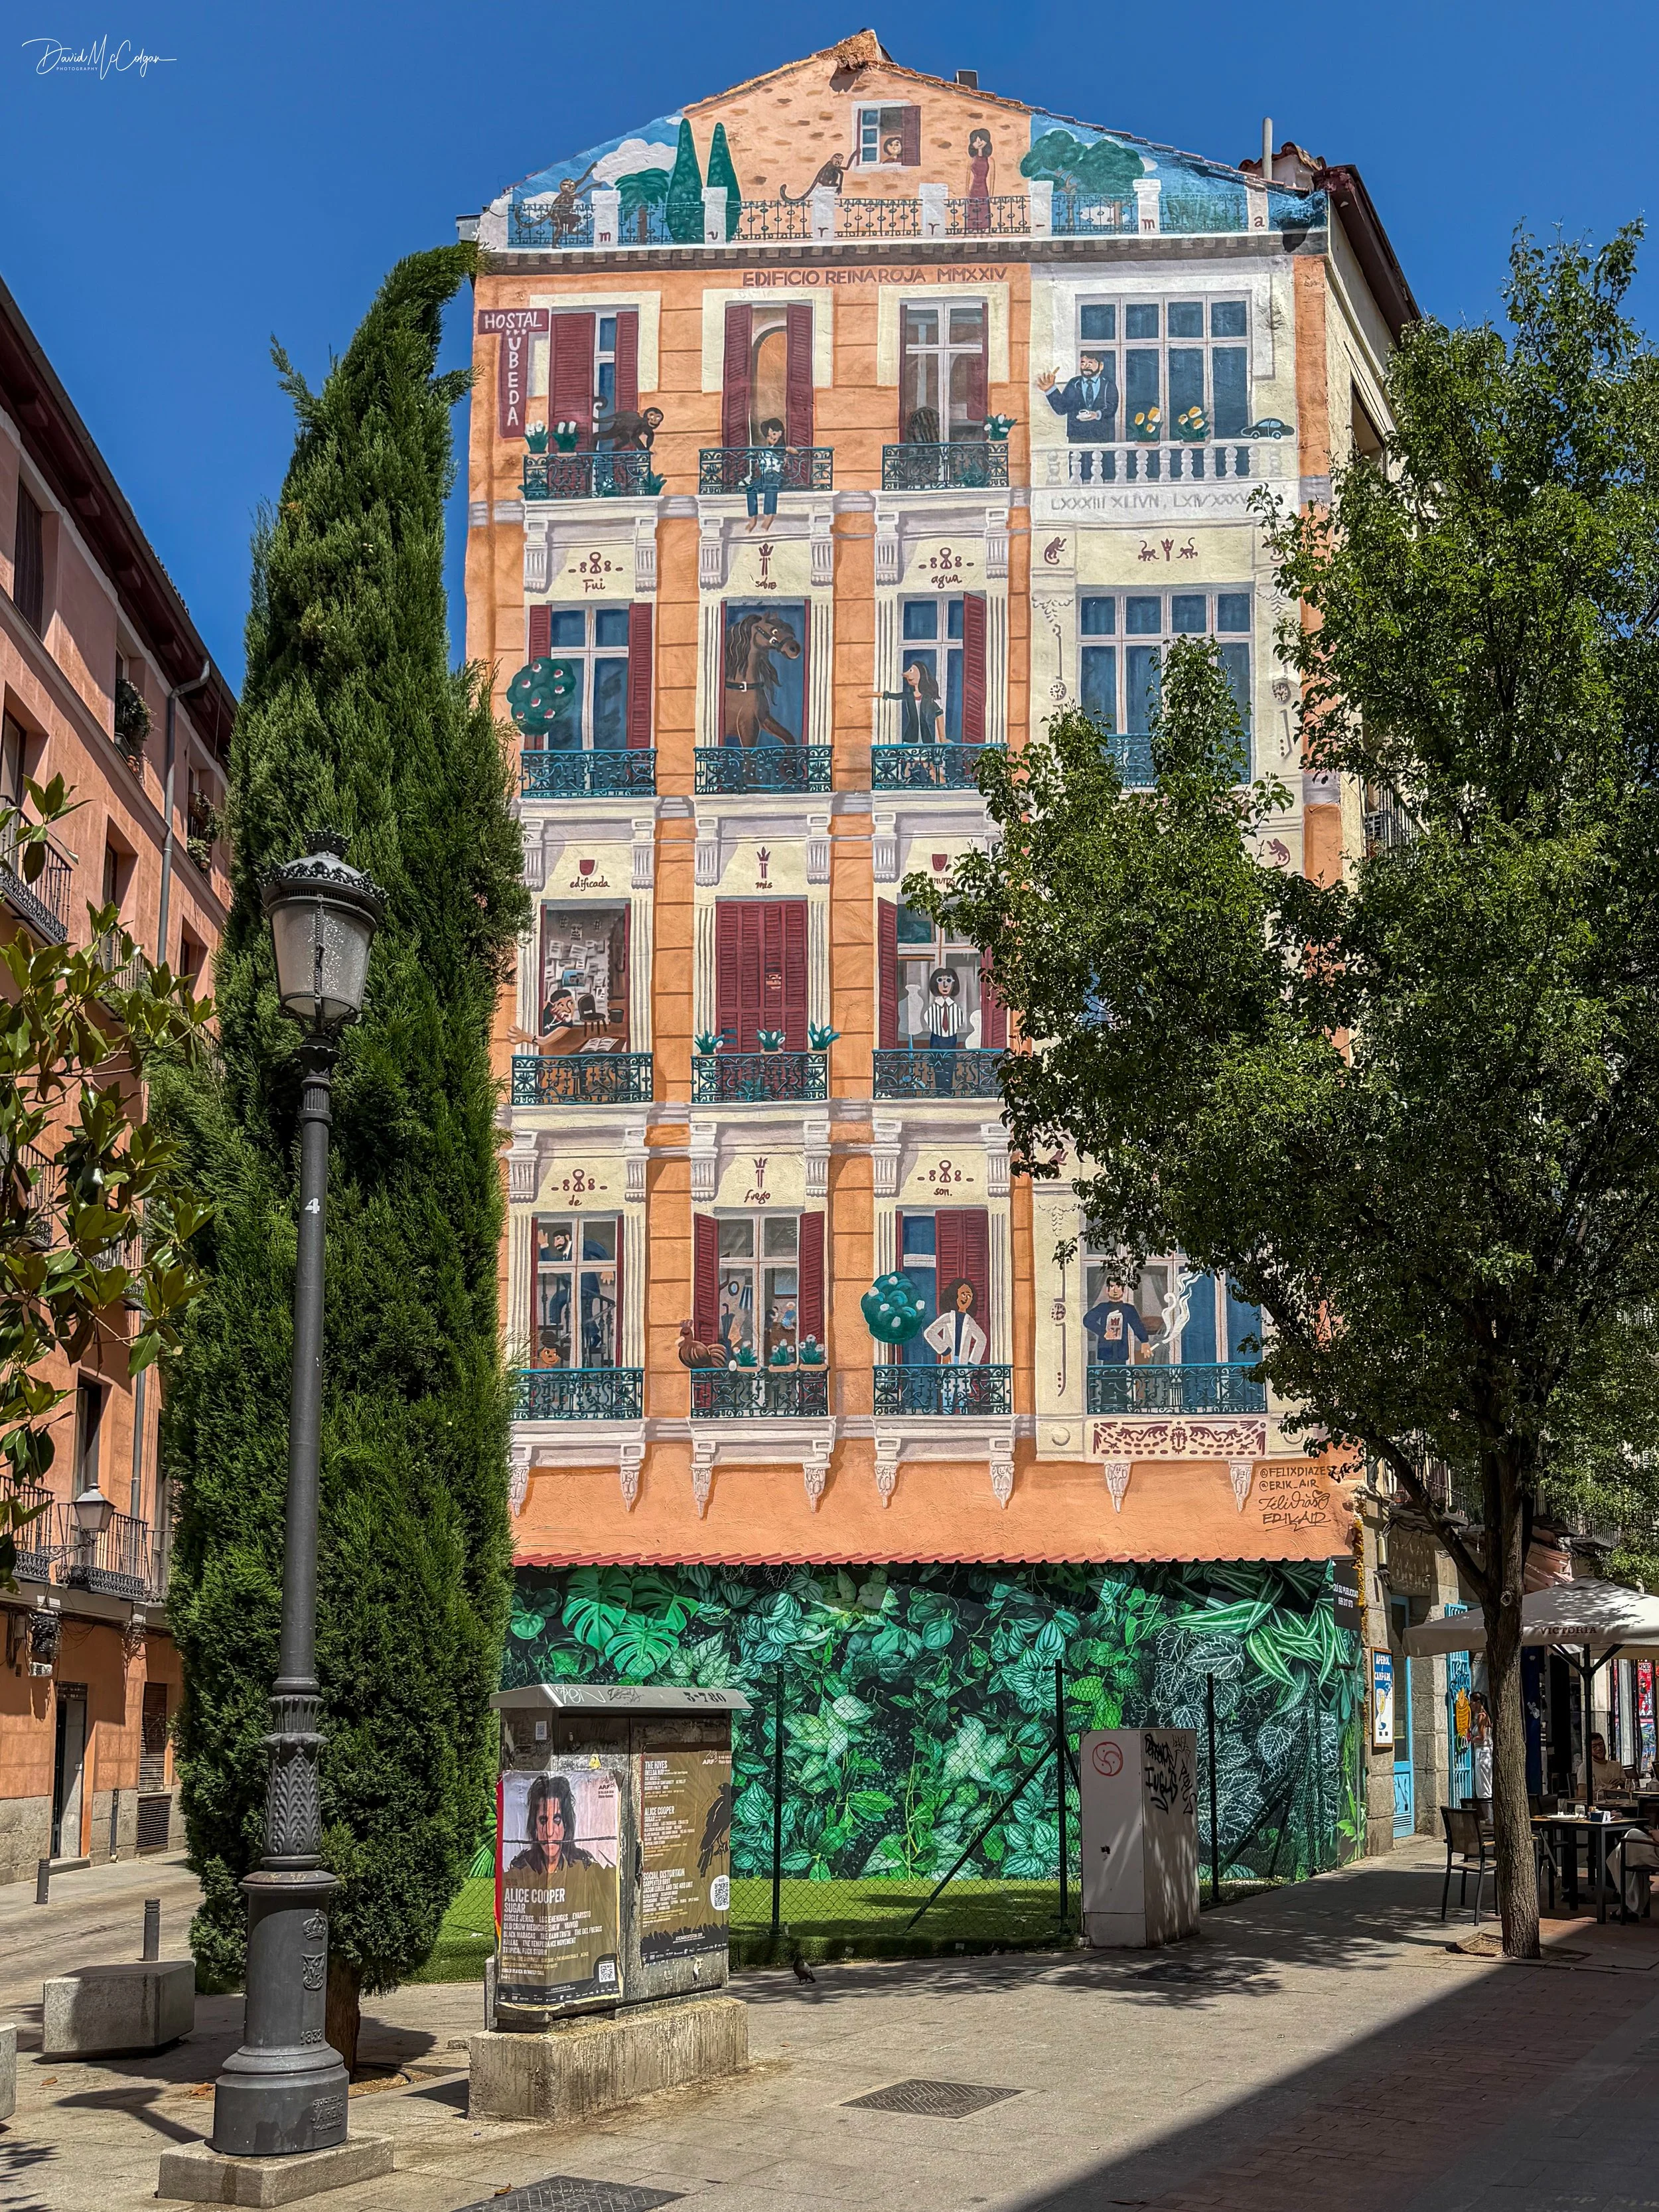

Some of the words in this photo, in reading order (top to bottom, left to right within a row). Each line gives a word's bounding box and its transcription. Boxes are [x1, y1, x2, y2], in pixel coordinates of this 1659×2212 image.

[743, 270, 820, 287] EDIFICIO
[937, 267, 1008, 283] MMXXIV
[484, 311, 543, 329] HOSTAL
[582, 577, 606, 592] Fui
[931, 573, 962, 589] agua
[569, 875, 611, 892] edificada
[755, 880, 773, 889] mis
[568, 1195, 583, 1207] de
[1259, 1479, 1319, 1492] @ERIK_AIR
[645, 1761, 654, 1769] THE
[654, 1761, 668, 1769] HIVES
[644, 1807, 657, 1816] ALICE
[657, 1806, 675, 1815] COOPER
[643, 1871, 658, 1881] SOCIAL
[659, 1868, 685, 1878] DISTORTION
[504, 1888, 530, 1903] ALICE
[531, 1887, 565, 1904] COOPER
[504, 1902, 526, 1914] SUGAR
[572, 1911, 591, 1920] EVARISTO
[548, 1923, 559, 1932] SHOW
[531, 1939, 556, 1948] TEMPERANCE
[556, 1937, 577, 1946] MOVEMENT
